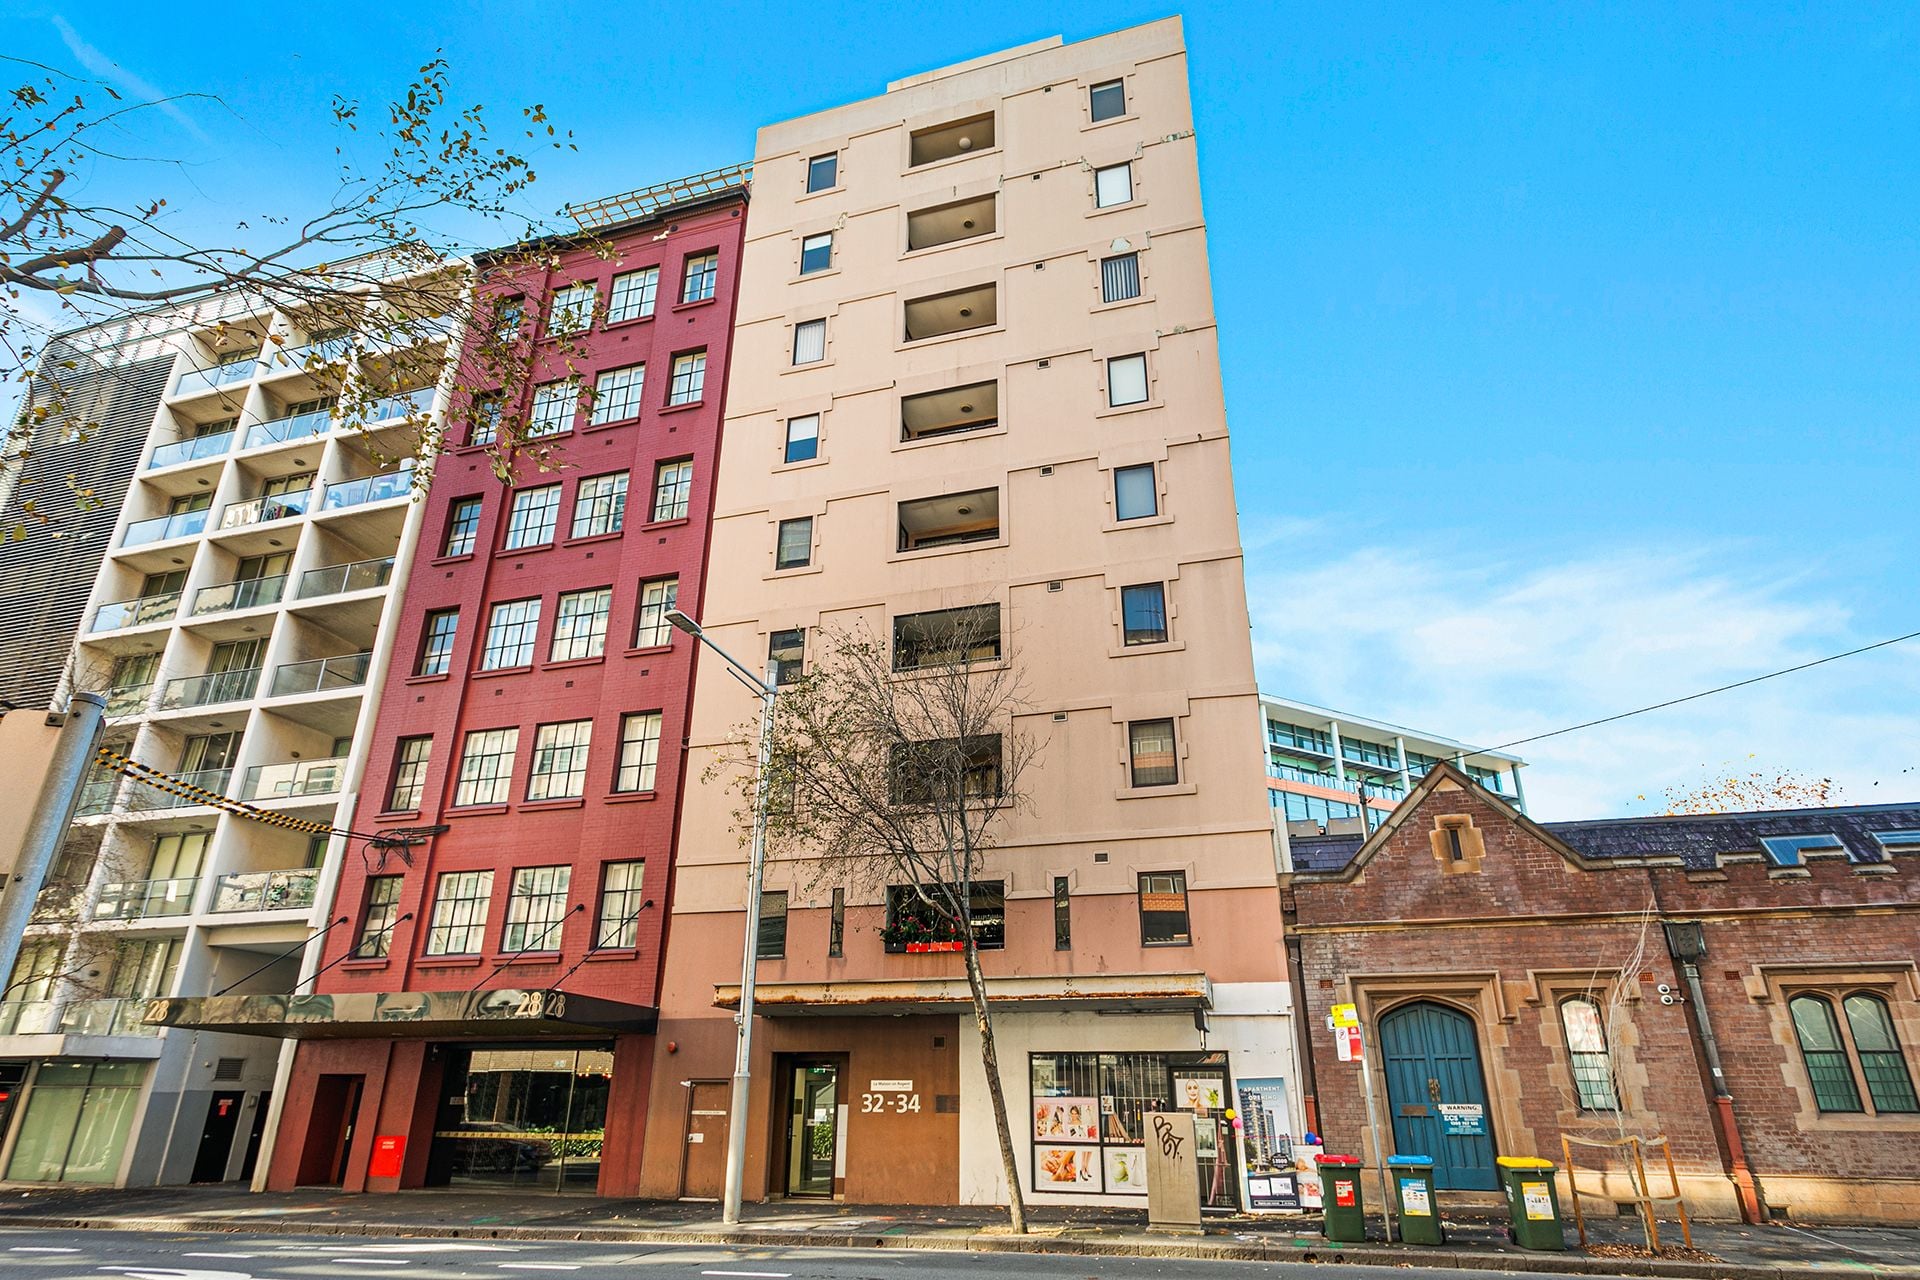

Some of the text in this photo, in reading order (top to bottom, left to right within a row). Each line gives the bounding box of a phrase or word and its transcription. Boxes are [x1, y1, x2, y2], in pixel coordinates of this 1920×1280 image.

[143, 1000, 170, 1022] 28
[515, 991, 542, 1016] 28
[545, 992, 566, 1018] 28
